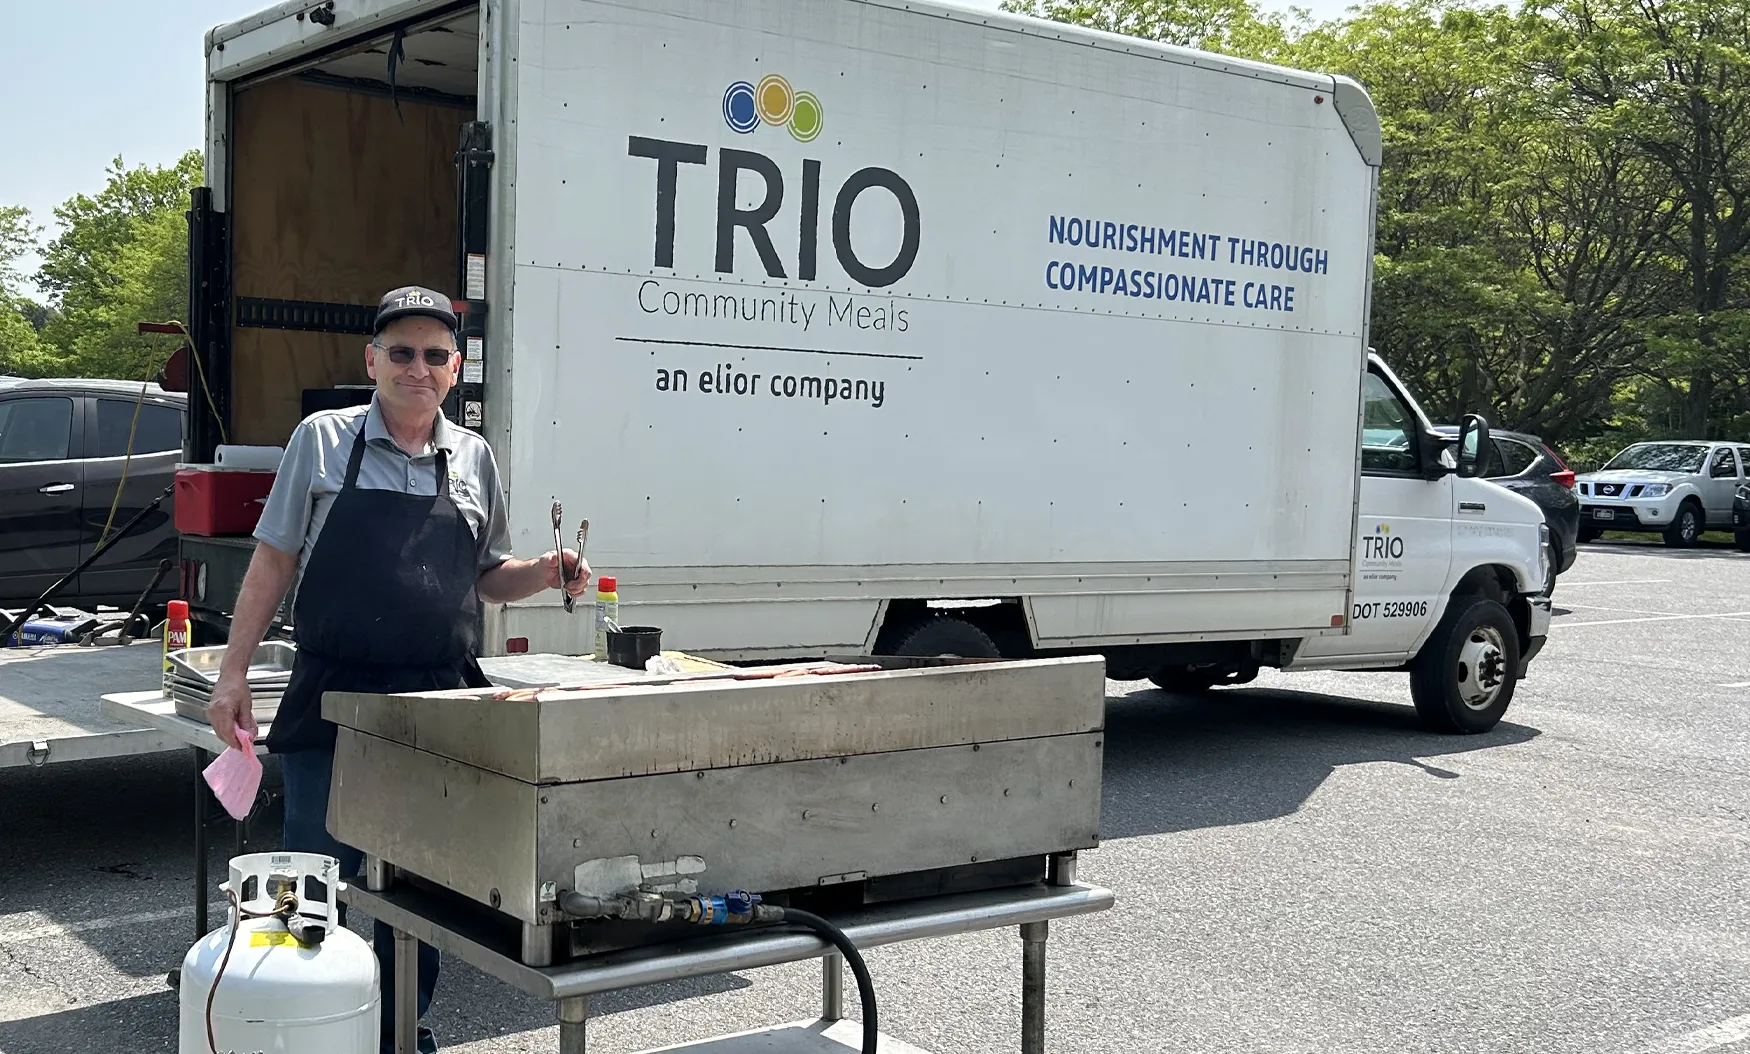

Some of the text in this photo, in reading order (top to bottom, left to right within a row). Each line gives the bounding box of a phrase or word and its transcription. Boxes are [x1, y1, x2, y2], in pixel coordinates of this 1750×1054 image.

[628, 135, 921, 288] TRIO
[1049, 215, 1329, 275] NOURISHMENT THROUGH
[395, 295, 435, 308] TRIO
[638, 280, 910, 332] Community Meals
[1046, 261, 1295, 312] COMPASSIONATE CARE
[656, 363, 885, 408] an elior company
[1363, 536, 1404, 559] TRIO
[1352, 601, 1428, 619] DOT 529906
[168, 631, 187, 644] PAM
